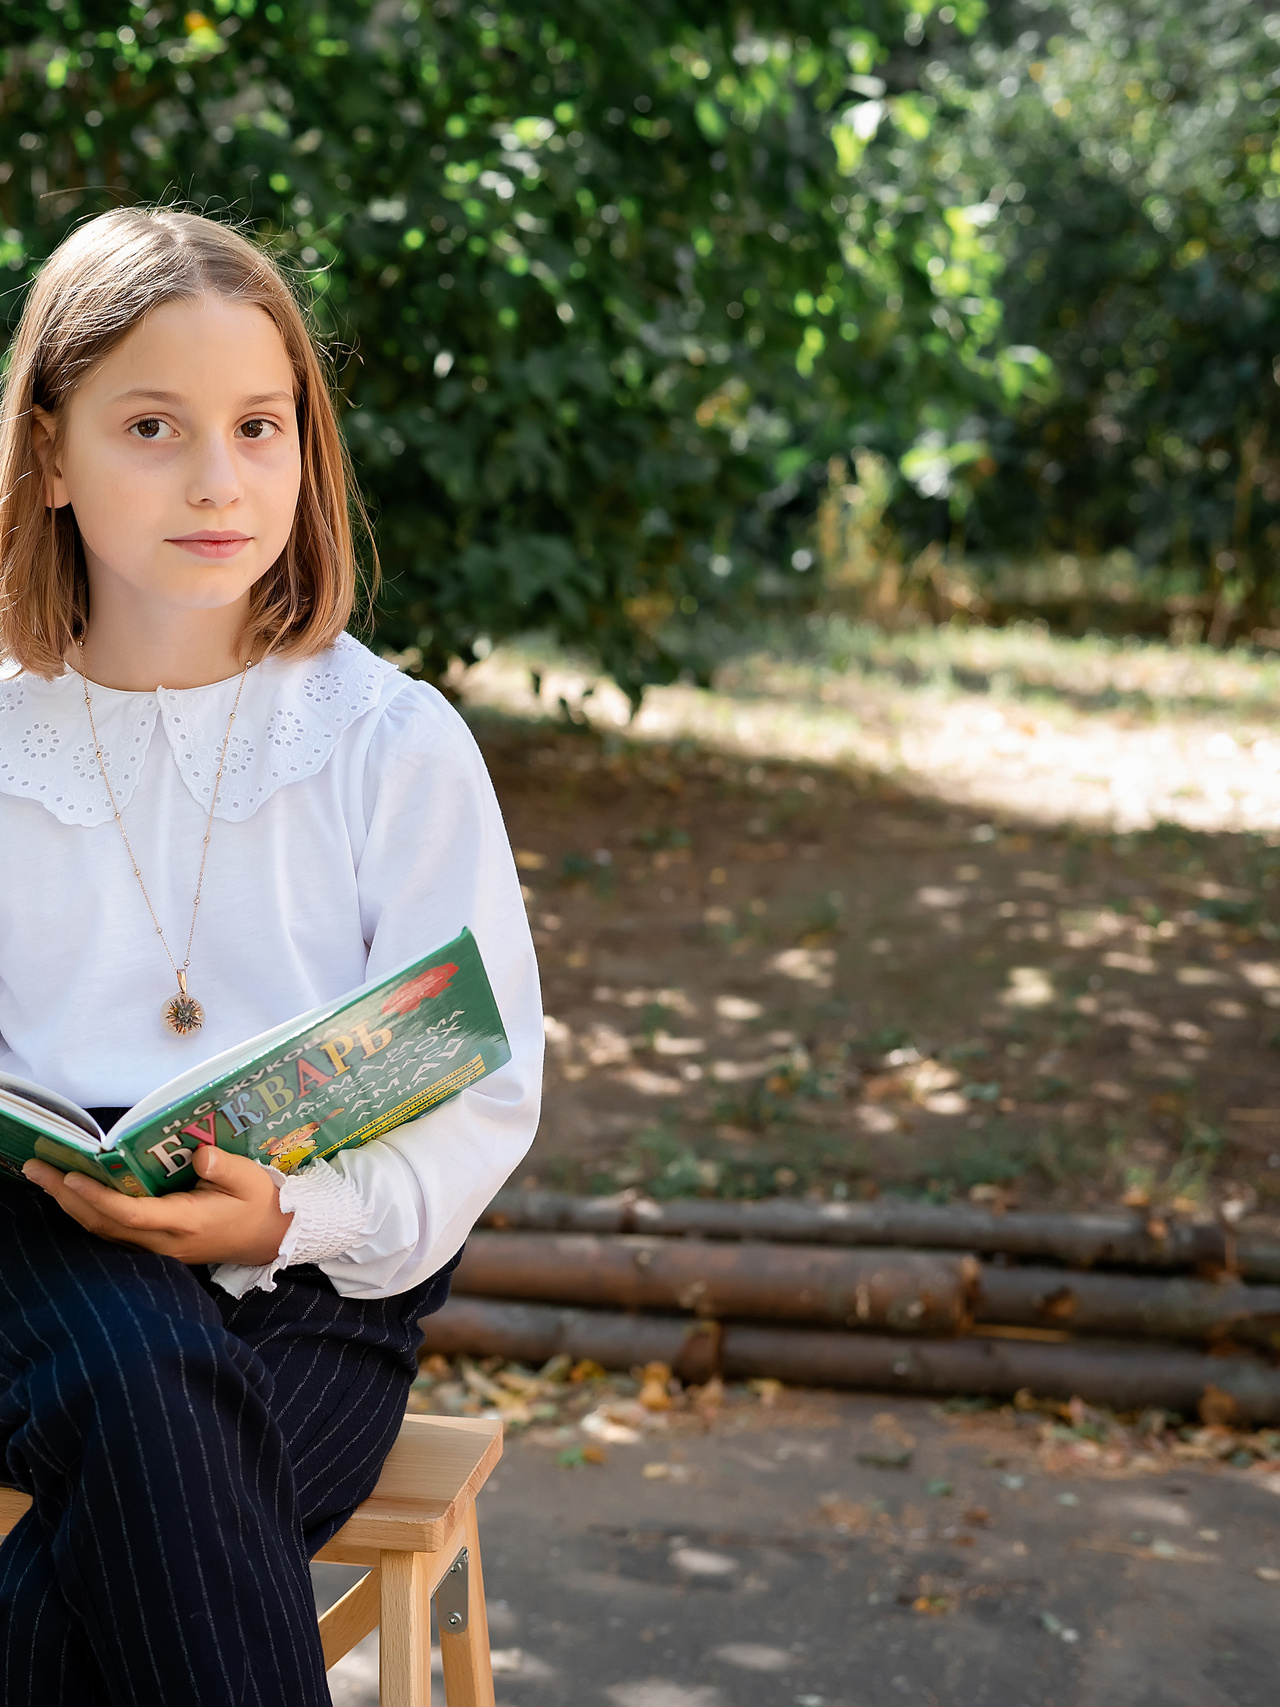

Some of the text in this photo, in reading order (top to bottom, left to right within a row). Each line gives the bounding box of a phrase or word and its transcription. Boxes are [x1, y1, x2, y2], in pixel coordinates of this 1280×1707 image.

[386, 1010, 465, 1058] РА-МА
[414, 1020, 461, 1053] ОХ
[224, 1028, 340, 1098] ЖУКОВА
[343, 1058, 418, 1103] РО-ЗА
[147, 1020, 393, 1178] БУКВАРЬ
[266, 1065, 376, 1130] МА-МА
[299, 1077, 365, 1119] МЫ-ЛО
[350, 1077, 399, 1114] АМ
[356, 1077, 428, 1122] ЛУ-НА
